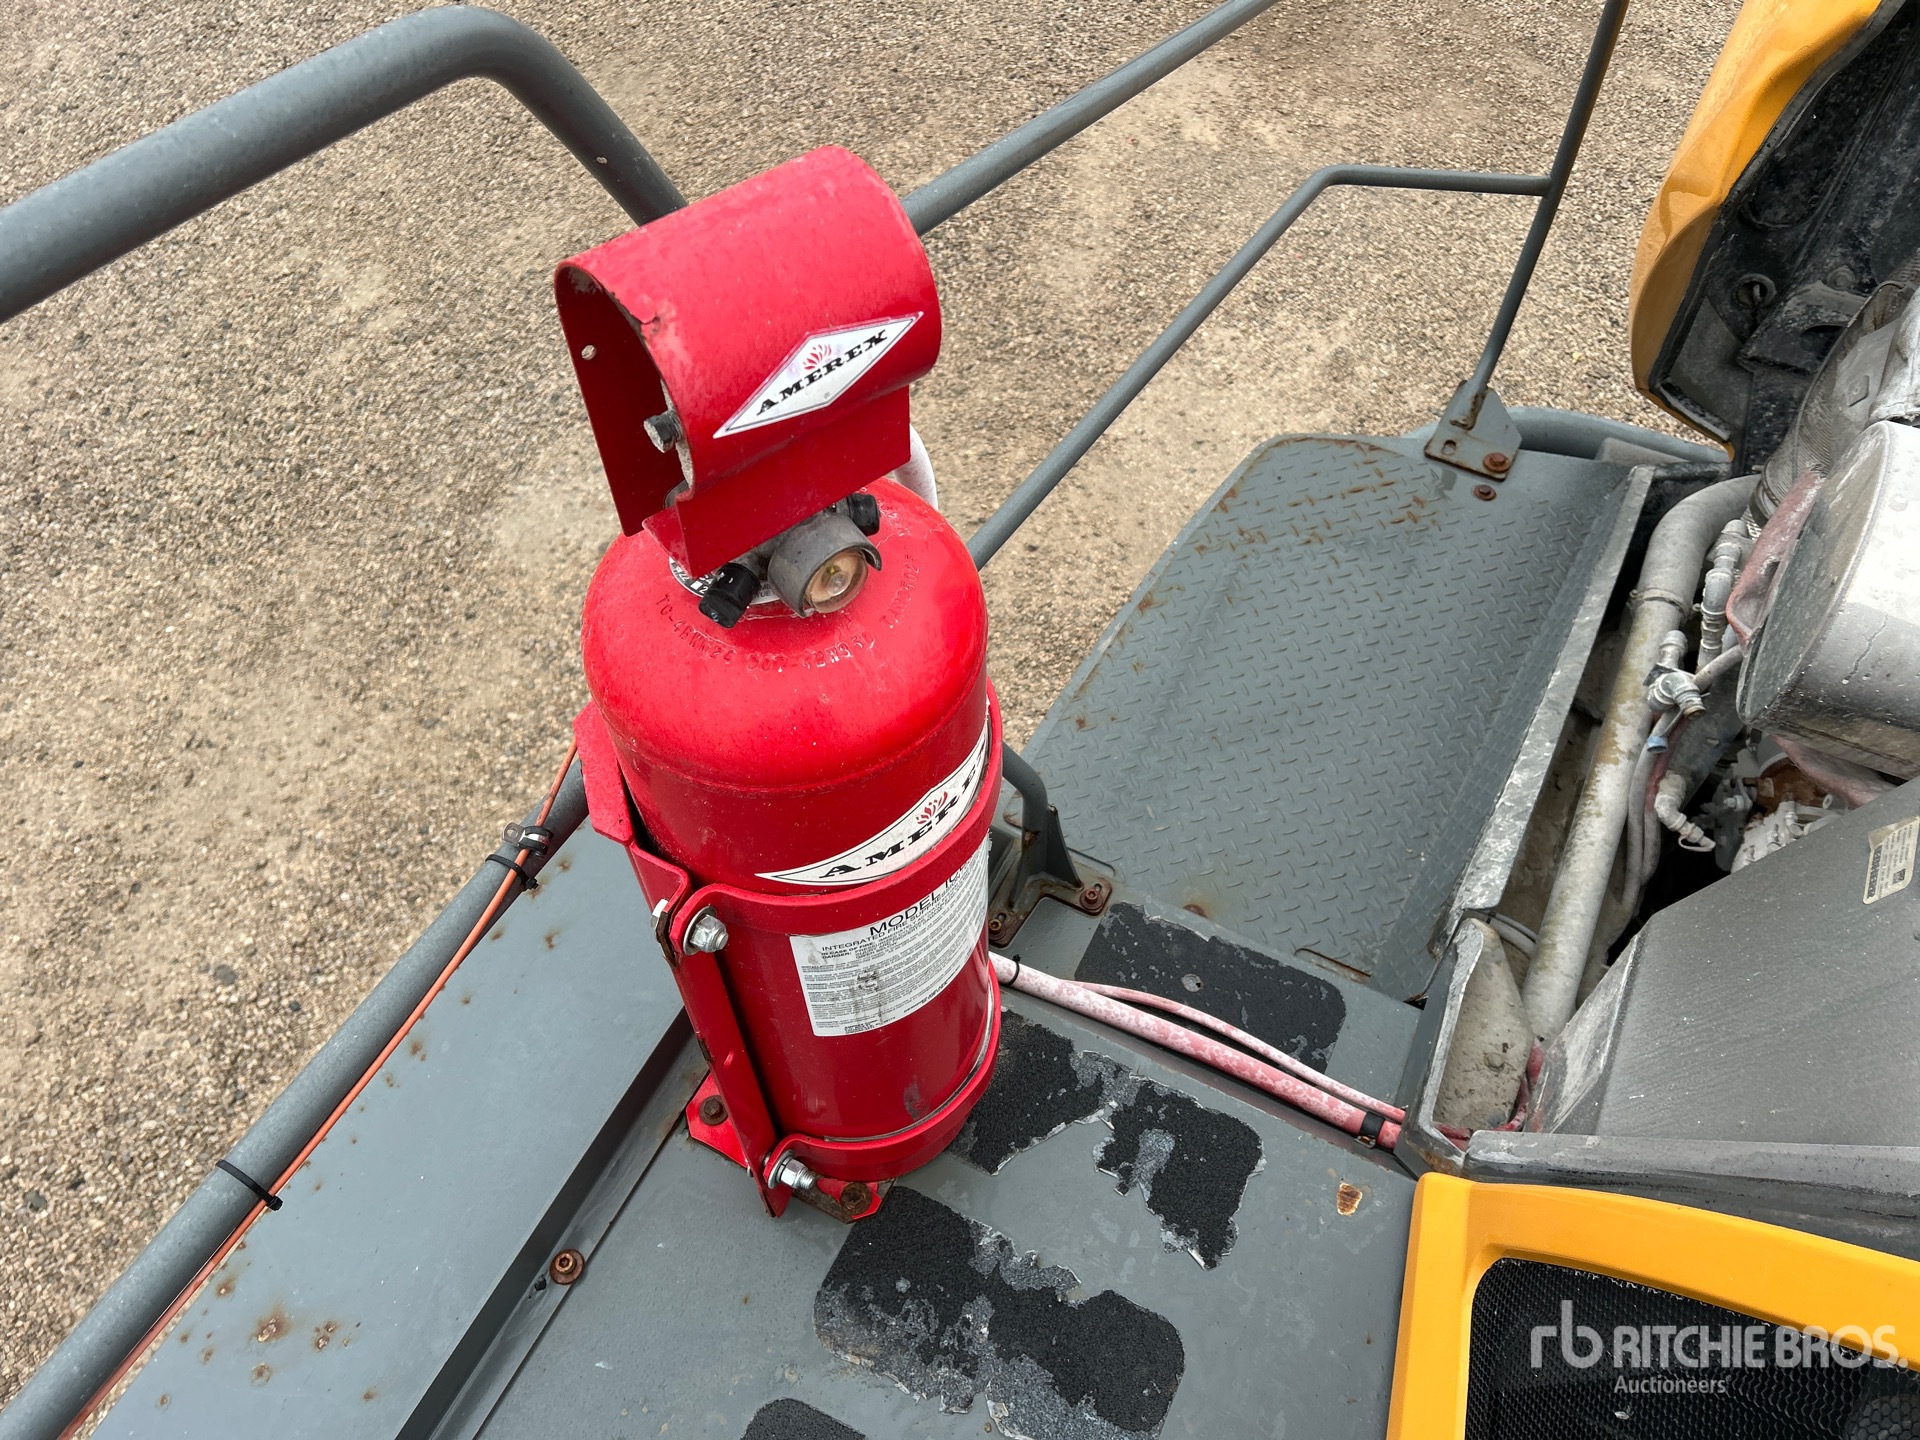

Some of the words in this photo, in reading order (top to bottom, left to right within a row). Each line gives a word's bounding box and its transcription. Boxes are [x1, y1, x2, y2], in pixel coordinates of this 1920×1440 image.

[757, 329, 887, 415] AMEREX
[822, 931, 885, 952] INTEGRATED
[888, 919, 907, 934] FIRE
[870, 892, 941, 936] MODEL
